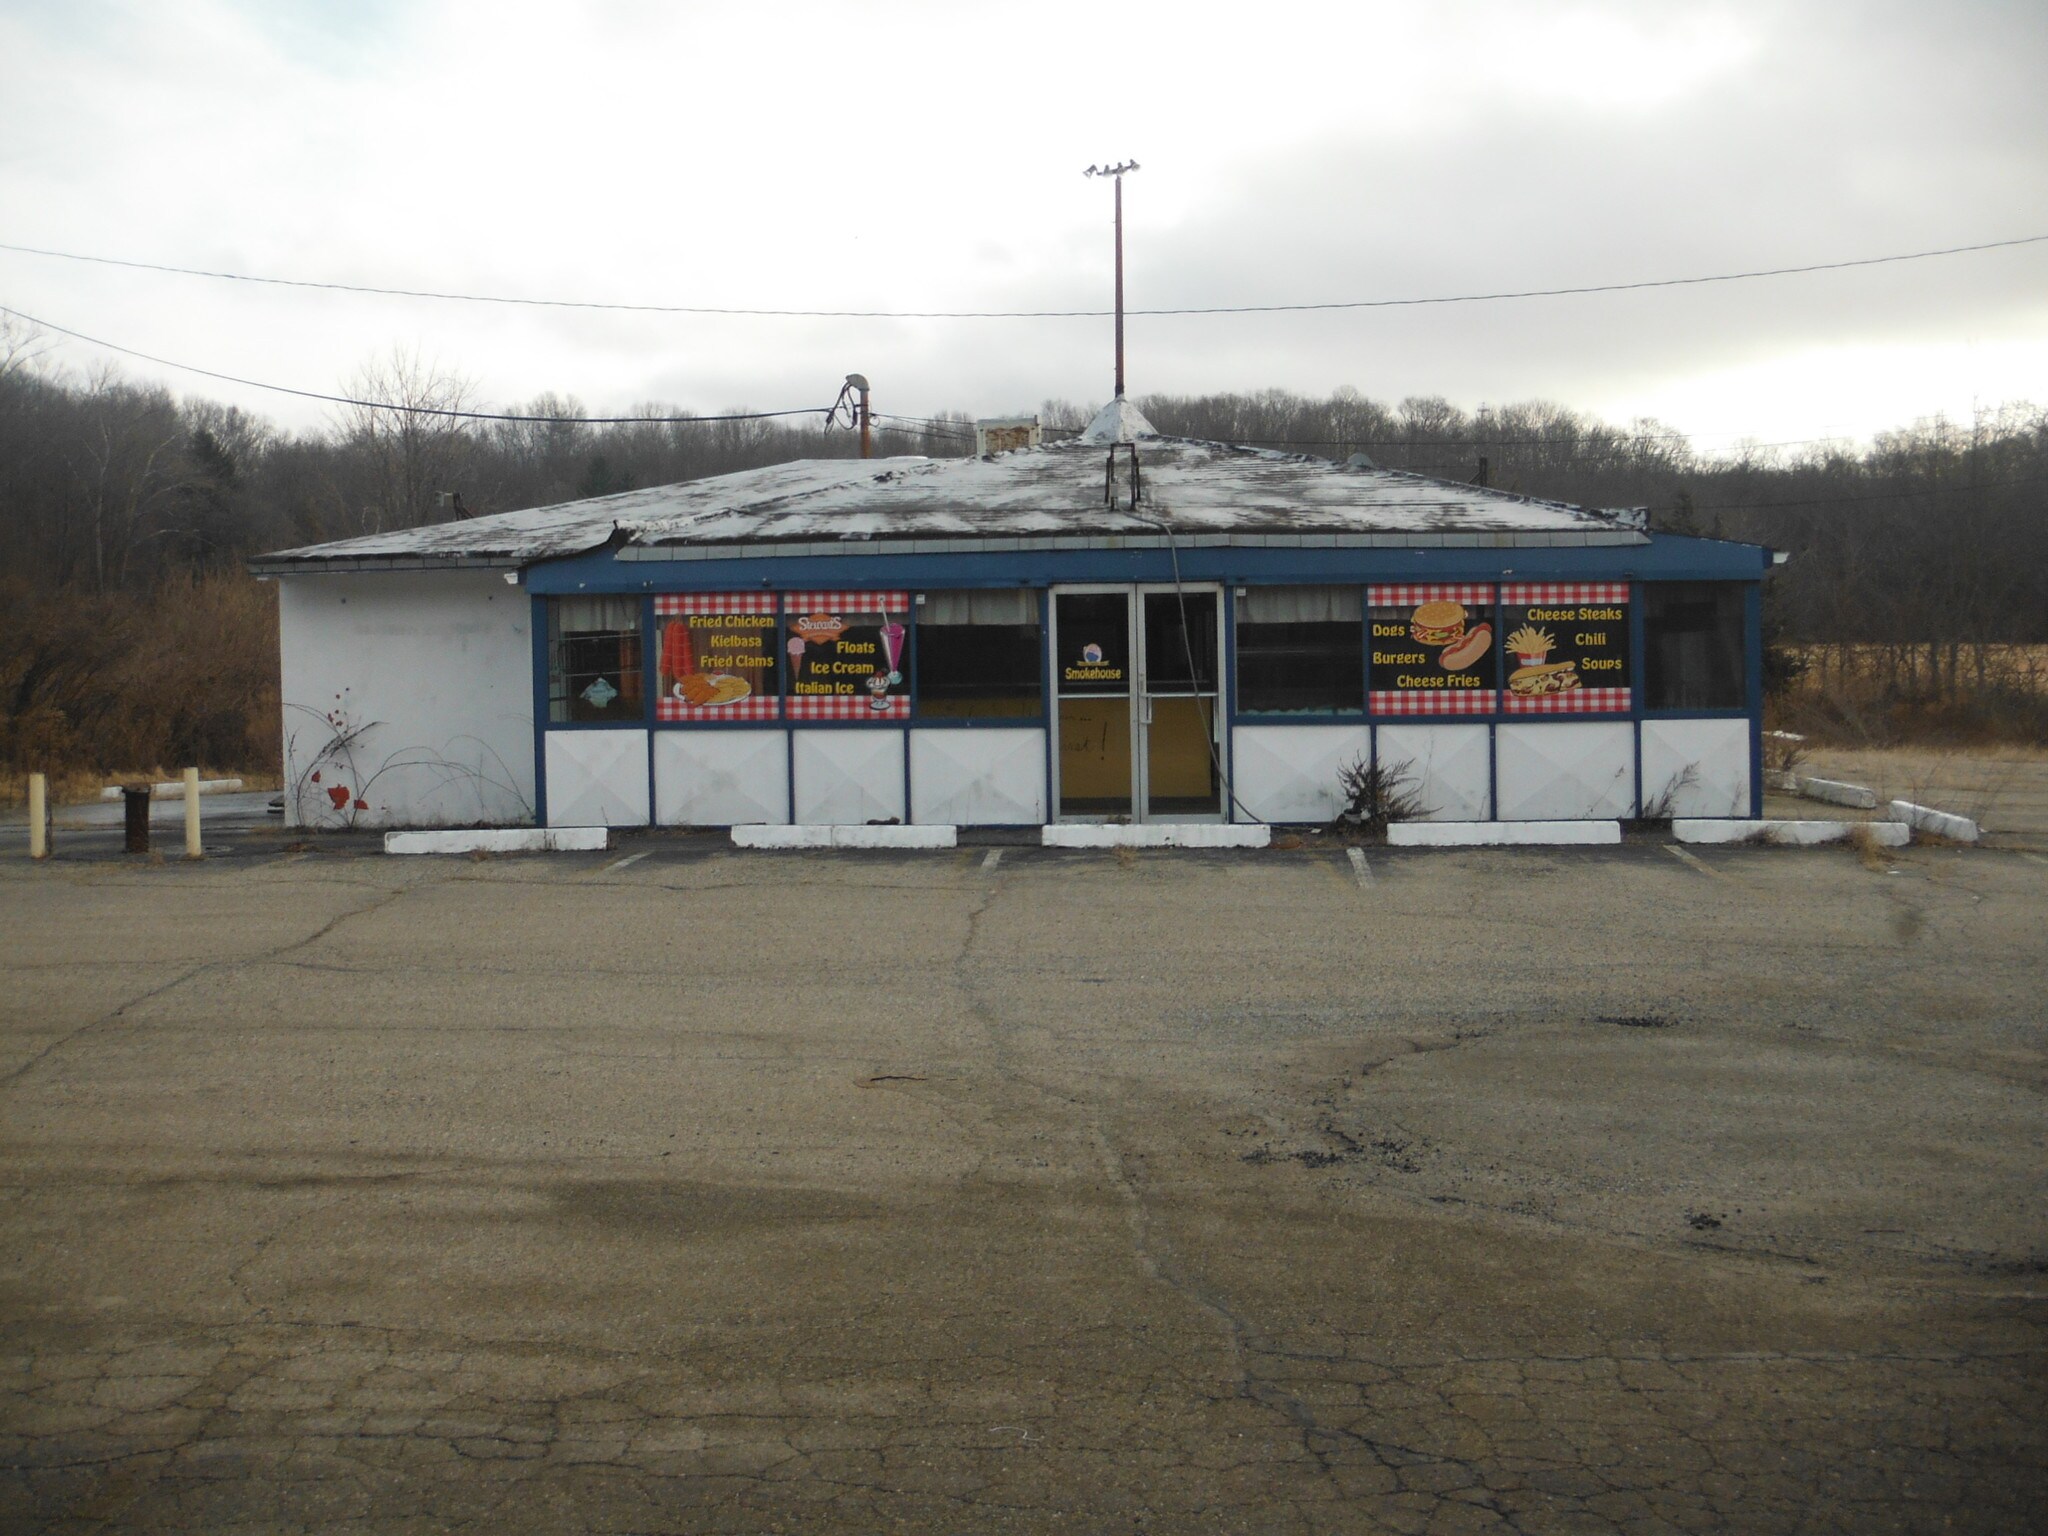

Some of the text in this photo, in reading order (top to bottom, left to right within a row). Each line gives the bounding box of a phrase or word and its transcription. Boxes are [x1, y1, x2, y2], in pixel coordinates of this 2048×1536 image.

[1528, 608, 1622, 621] Cheese Steaks
[690, 616, 774, 628] Fried Chicken
[1373, 624, 1405, 637] Dogs
[711, 635, 762, 648] Kielbasa
[1575, 633, 1606, 645] Chili
[837, 641, 875, 654] Floats
[700, 655, 774, 668] Fried Clams
[1373, 652, 1425, 666] Burgers
[1581, 658, 1622, 670] Soups
[811, 661, 874, 674] Ice Cream
[1065, 667, 1121, 680] Smokehouse
[1397, 675, 1480, 688] Cheese Fries
[795, 682, 854, 695] Italian Ice
